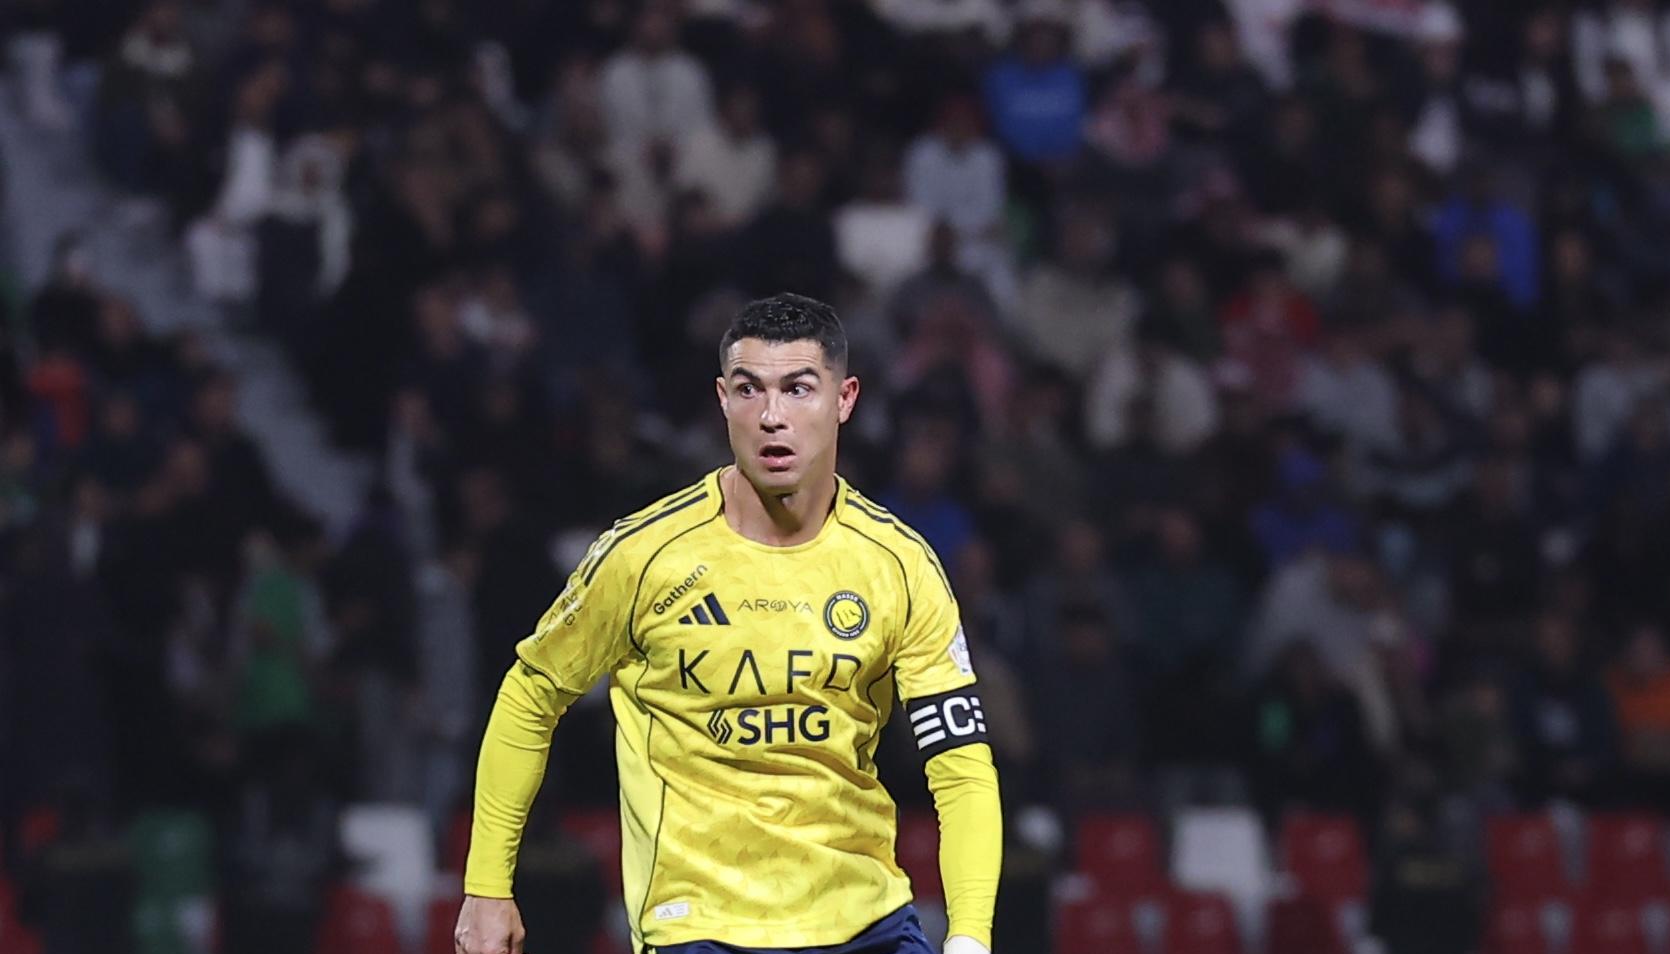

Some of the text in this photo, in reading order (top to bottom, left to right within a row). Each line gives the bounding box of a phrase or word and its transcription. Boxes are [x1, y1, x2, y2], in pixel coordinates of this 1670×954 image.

[653, 563, 708, 616] Gathern
[736, 598, 814, 614] AROYA
[678, 648, 862, 696] KAFD
[737, 704, 831, 746] SHG
